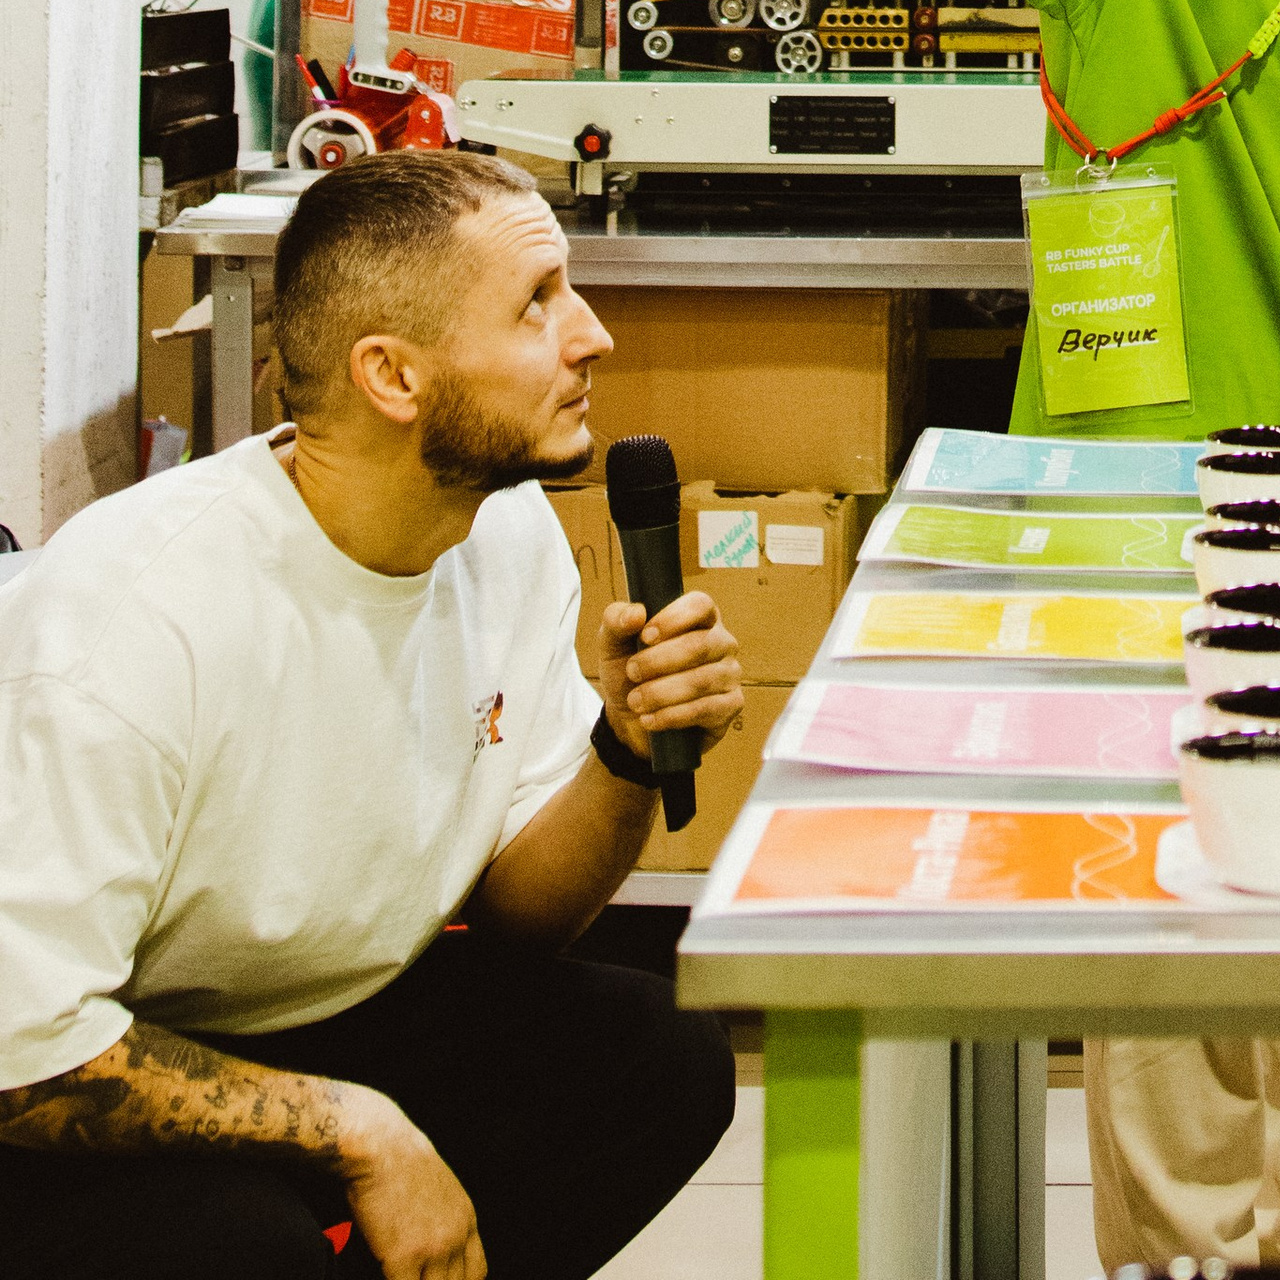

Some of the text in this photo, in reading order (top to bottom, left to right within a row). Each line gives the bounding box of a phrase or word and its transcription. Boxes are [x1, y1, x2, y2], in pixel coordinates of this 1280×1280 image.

[1046, 243, 1130, 261] RB FUNKY CUP
[1047, 254, 1142, 273] TASTERS BATTLE
[1051, 293, 1156, 317] ОРГАНИЗАТОР
